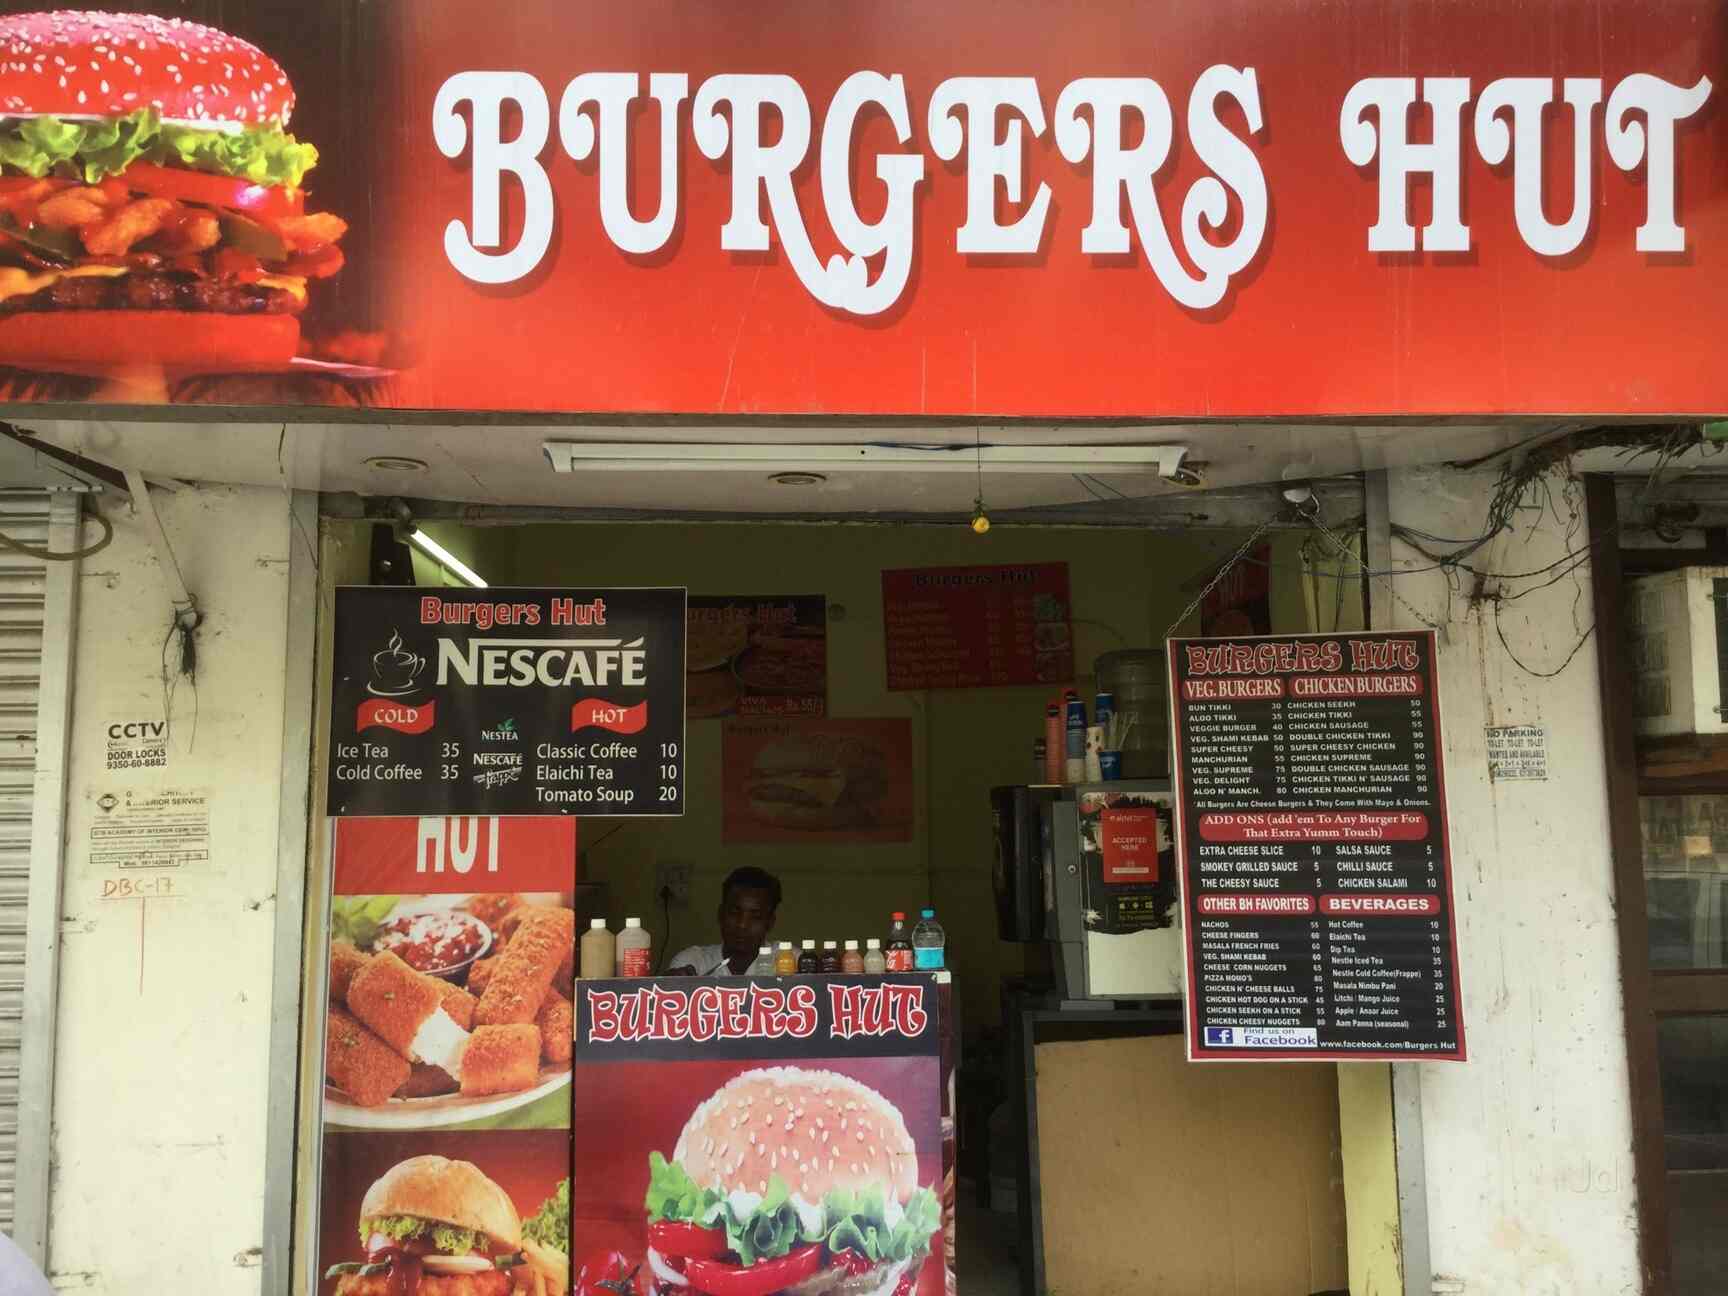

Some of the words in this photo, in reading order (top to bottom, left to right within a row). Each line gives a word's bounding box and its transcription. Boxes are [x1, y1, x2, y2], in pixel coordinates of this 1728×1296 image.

[433, 64, 1267, 314] BURGERS
[1340, 73, 1713, 256] HUT
[420, 597, 540, 629] Burgers
[551, 598, 606, 625] Hut
[436, 637, 647, 686] NESCAFÉ
[1187, 641, 1343, 675] BURGERS
[1350, 639, 1419, 672] HUT
[1187, 680, 1217, 697] VEG.
[1219, 679, 1281, 696] BURGERS
[1295, 677, 1356, 694] CHICKEN
[1357, 676, 1416, 693] BURGERS
[375, 710, 418, 723] COLD
[592, 710, 626, 723] HOT
[108, 722, 164, 739] CCTV
[482, 730, 518, 741] NESTEA
[1503, 729, 1543, 737] PARKING
[108, 751, 133, 760] DOOR
[135, 750, 166, 759] LOCKS
[337, 745, 359, 758] Ice
[364, 744, 389, 758] Tea
[441, 744, 459, 757] 35
[537, 744, 585, 758] Classic
[589, 744, 637, 758] Coffee
[661, 744, 677, 757] 10
[337, 765, 370, 780] Cold
[375, 765, 422, 780] Coffee
[441, 766, 459, 779] 35
[537, 765, 583, 780] Elaichi
[588, 766, 613, 780] Tea
[661, 766, 677, 779] 10
[536, 787, 591, 801] Tomato
[597, 787, 634, 804] Soup
[659, 787, 677, 801] 20
[1205, 816, 1233, 824] ADD
[1237, 815, 1264, 824] ONS
[1267, 814, 1293, 825] (add
[1295, 815, 1314, 823] 'em
[1318, 815, 1331, 823] To
[1335, 815, 1357, 826] Any
[1360, 814, 1397, 825] Burger
[1401, 814, 1421, 823] For
[1244, 829, 1268, 837] That
[1271, 828, 1301, 837] Extra
[1304, 829, 1342, 837] Yumm
[1343, 827, 1383, 838] Touch)
[1200, 846, 1225, 855] EXTRA
[1228, 846, 1259, 855] CHEESE
[1261, 846, 1283, 855] SLICE
[1312, 846, 1321, 854] 10
[1336, 846, 1362, 855] SALSA
[1364, 846, 1391, 854] SAUCE
[1427, 846, 1431, 854] 5
[1200, 863, 1234, 872] SMOKEY
[1236, 863, 1269, 871] GRILLED
[1272, 862, 1298, 871] SAUCE
[1314, 863, 1319, 871] 5
[1337, 863, 1363, 871] CHILLI
[1366, 863, 1392, 871] SAUCE
[1428, 863, 1433, 871] 5
[103, 878, 174, 896] DBC-17
[1202, 879, 1217, 888] THE
[1220, 879, 1249, 888] CHEESY
[1251, 879, 1279, 887] SAUCE
[1317, 879, 1321, 887] 5
[1338, 879, 1373, 887] CHICKEN
[1376, 879, 1407, 887] SALAMI
[1427, 879, 1436, 887] 10
[1204, 898, 1236, 910] OTHER
[1239, 899, 1253, 910] BH
[1256, 898, 1309, 910] FAVORITES
[1330, 899, 1429, 910] BEVERAGES
[1330, 946, 1341, 954] Dip
[588, 982, 818, 1044] BURGERS
[827, 983, 927, 1041] HUT
[1244, 1036, 1316, 1046] Facebook
[1320, 1041, 1437, 1050] www.facebook.com/Burgers
[1441, 1041, 1456, 1049] Hut
